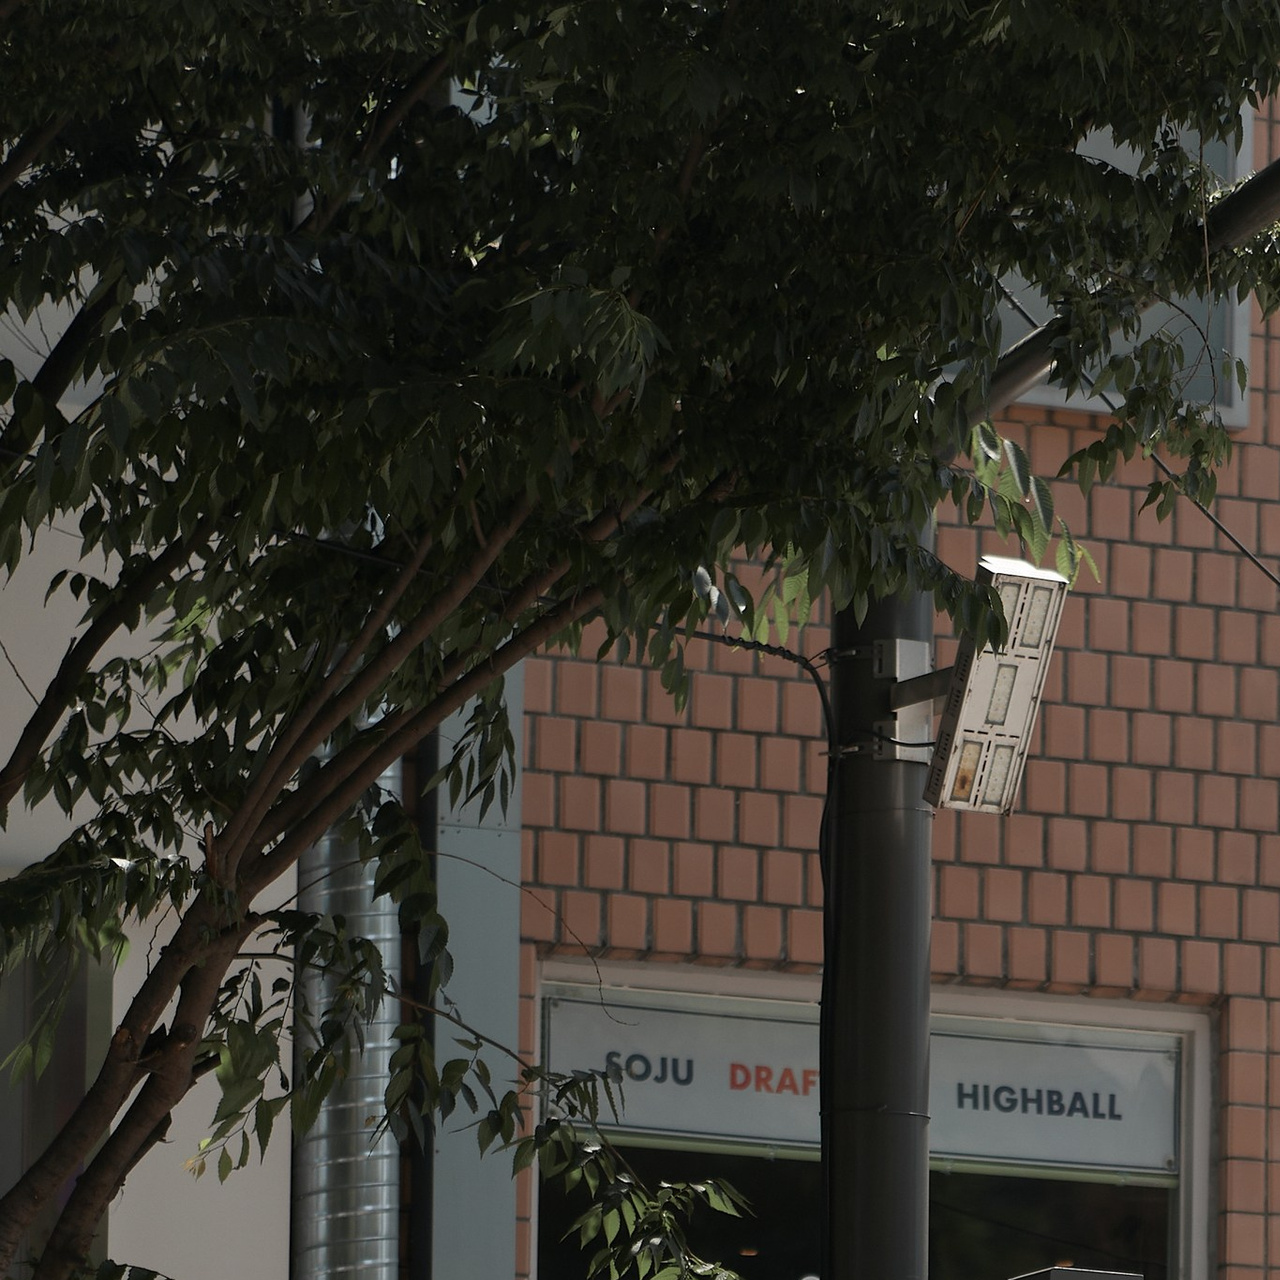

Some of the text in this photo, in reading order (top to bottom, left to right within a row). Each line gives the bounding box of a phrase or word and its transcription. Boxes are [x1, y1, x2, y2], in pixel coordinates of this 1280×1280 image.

[604, 1051, 694, 1087] SOJU
[729, 1063, 820, 1097] DRAF
[956, 1082, 1122, 1122] HIGHBALL
